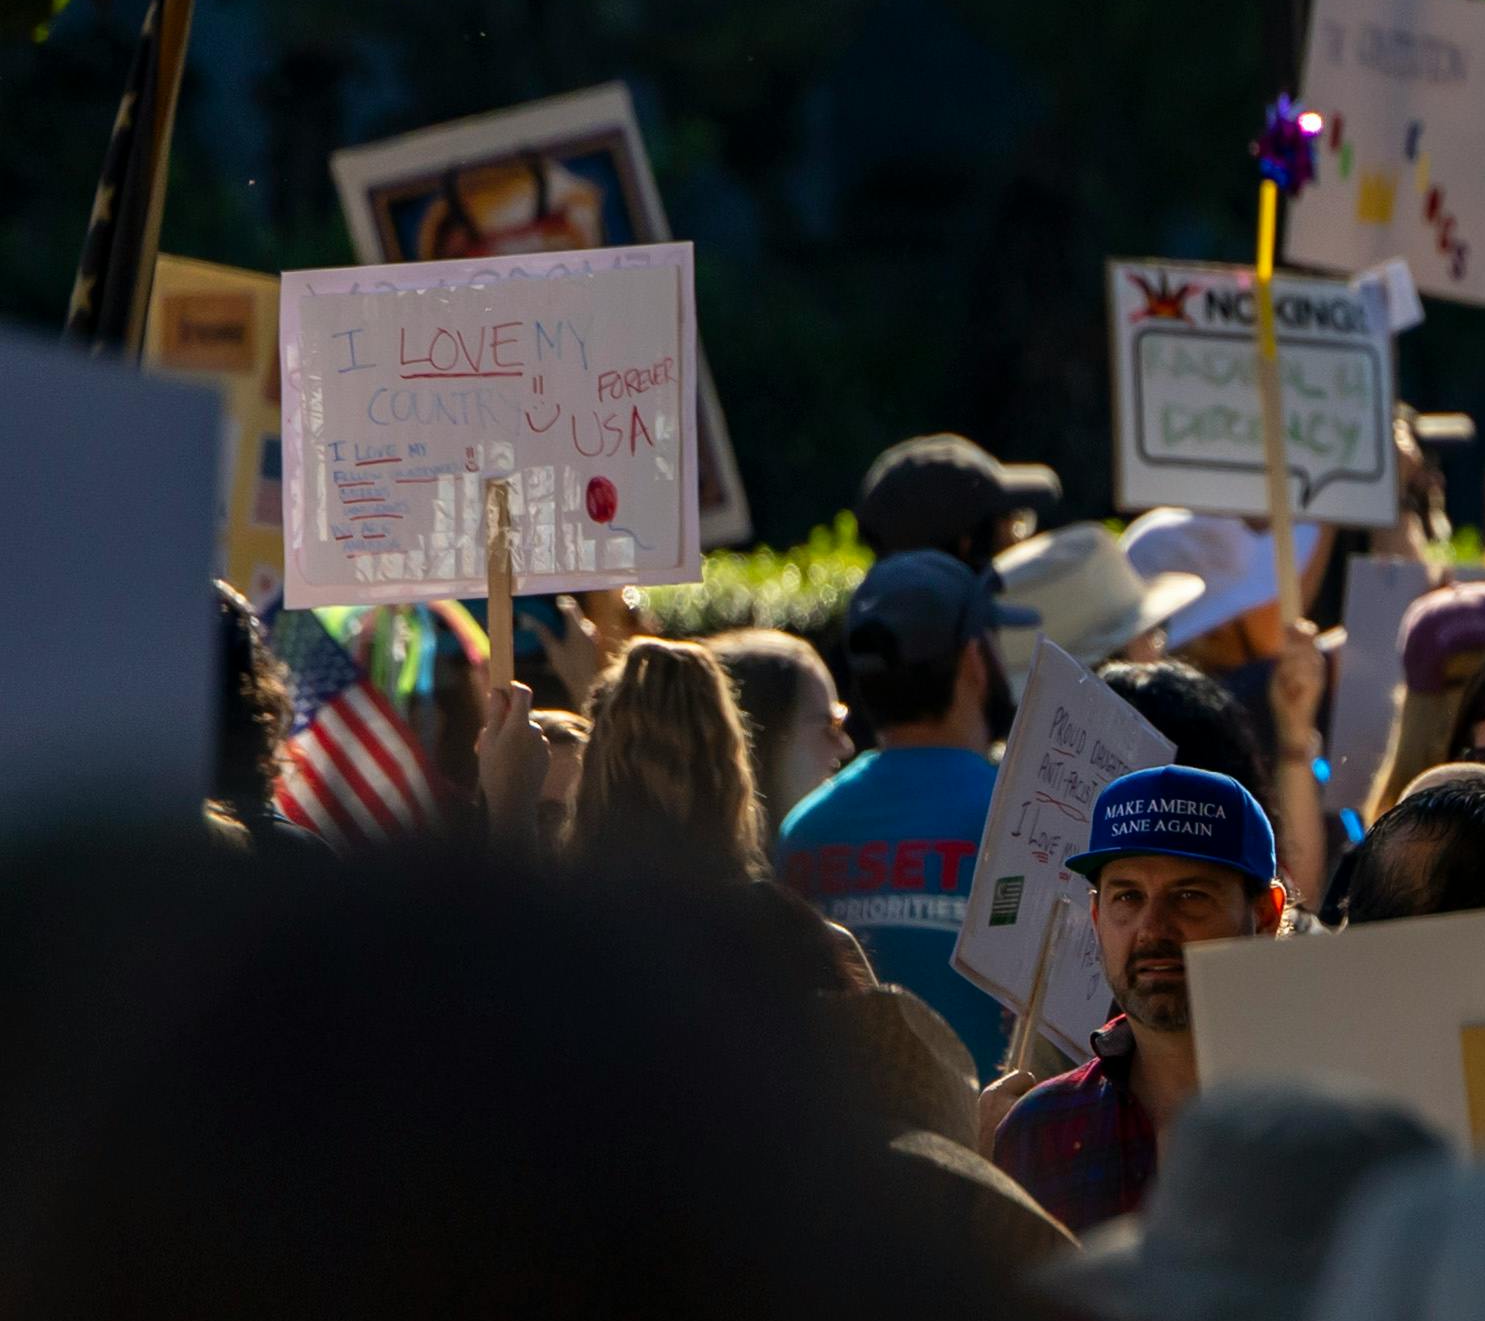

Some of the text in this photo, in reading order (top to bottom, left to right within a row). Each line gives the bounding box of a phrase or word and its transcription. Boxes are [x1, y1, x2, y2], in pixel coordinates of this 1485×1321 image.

[331, 319, 589, 373] I LOVE MY
[596, 356, 680, 404] FOREVER
[570, 404, 655, 460] USA
[1048, 706, 1088, 755] PROUD
[1104, 797, 1227, 820] MAKE AMERICA
[1110, 819, 1213, 838] SANE AGAIN
